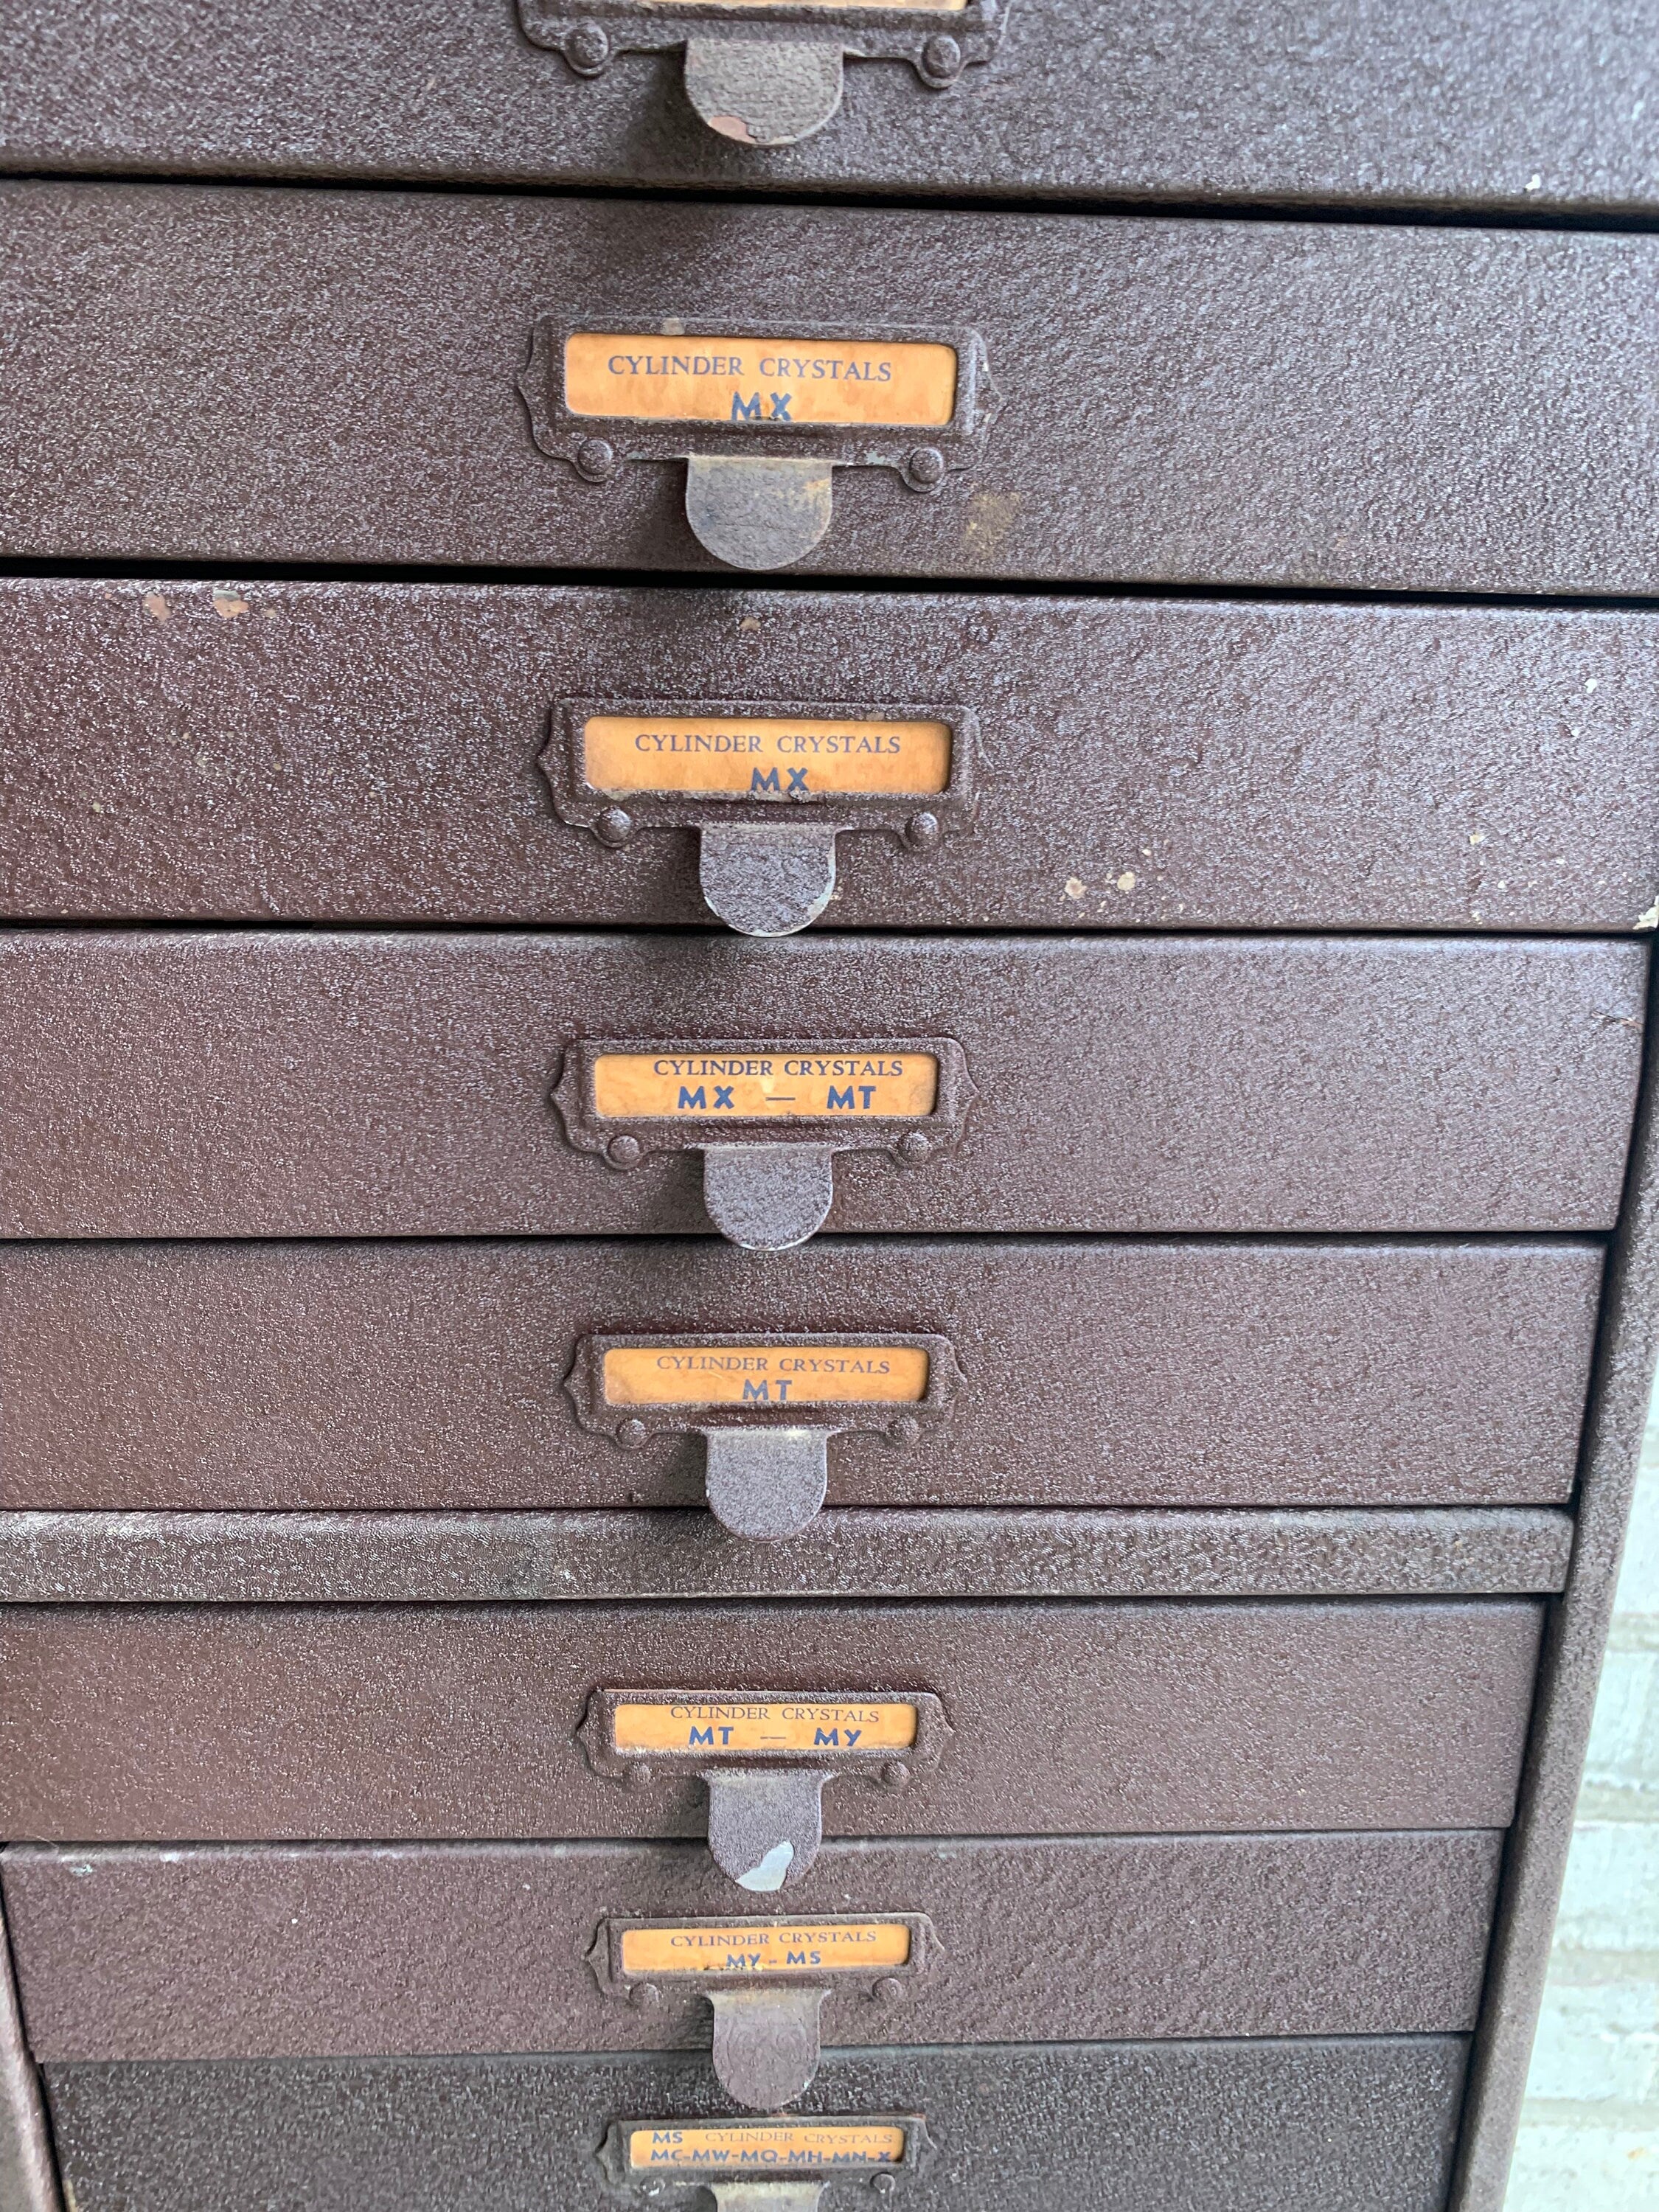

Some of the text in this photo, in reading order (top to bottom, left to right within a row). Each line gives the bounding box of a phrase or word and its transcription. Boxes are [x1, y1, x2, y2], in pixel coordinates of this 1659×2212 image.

[608, 355, 892, 382] CYLINDER CRYSTALS
[731, 391, 793, 422] MX
[635, 734, 901, 755] CYLINDER CRYSTALS
[751, 767, 810, 792] MX
[654, 1060, 903, 1077] CYLINDER CRYSTALS
[678, 1085, 734, 1110] MX
[827, 1085, 877, 1110] MT
[657, 1355, 891, 1374] CYLINDER CRYSTALS
[742, 1378, 793, 1401] MT
[670, 1705, 880, 1723] CYLINDER CRYSTALS
[688, 1726, 734, 1746] MT
[813, 1727, 863, 1747] MY
[670, 1930, 877, 1947] CYLINDER CRYSTALS
[726, 1952, 762, 1968] MY
[786, 1950, 821, 1965] MS
[652, 2131, 893, 2144] MS CYLINDER CRYSTALS
